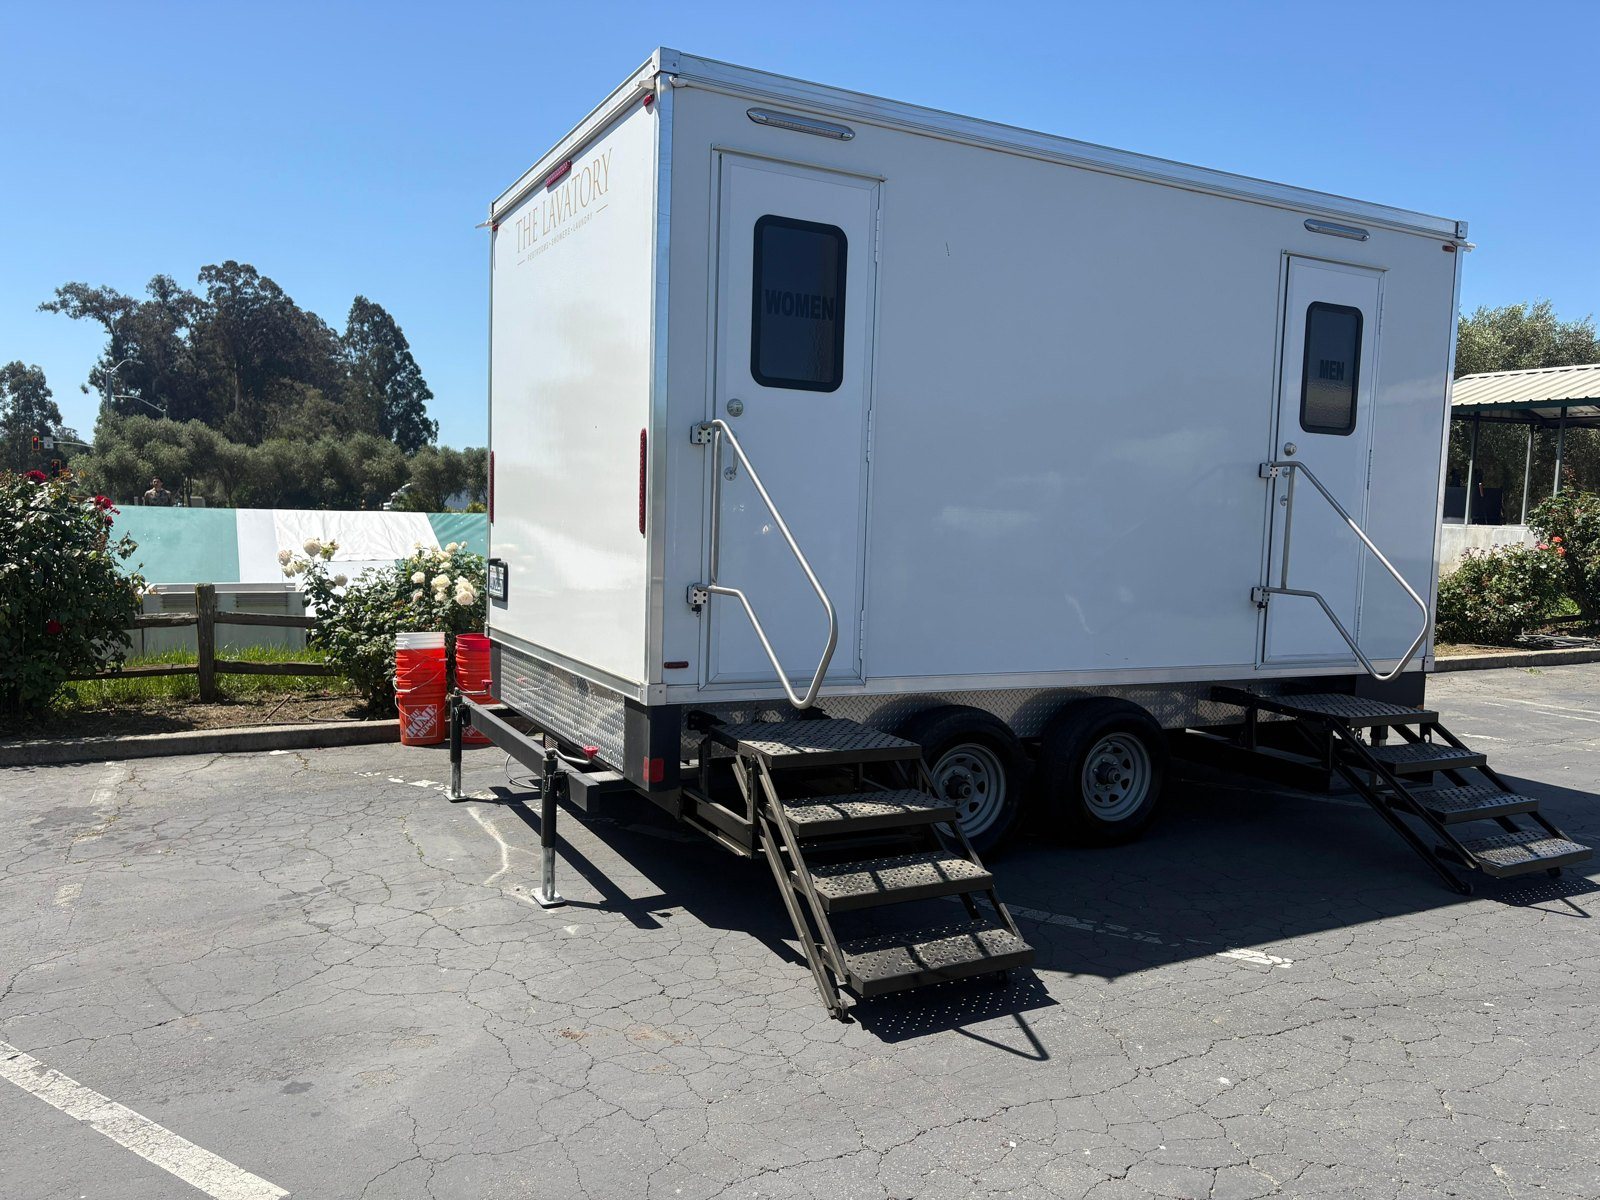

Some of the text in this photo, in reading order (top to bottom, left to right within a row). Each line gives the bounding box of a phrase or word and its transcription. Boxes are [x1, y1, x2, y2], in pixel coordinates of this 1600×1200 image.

[516, 147, 612, 254] THE LAVATORY
[765, 289, 835, 320] WOMEN
[1319, 359, 1345, 381] MEN
[406, 705, 437, 738] HOME
[417, 717, 437, 737] DEPOT
